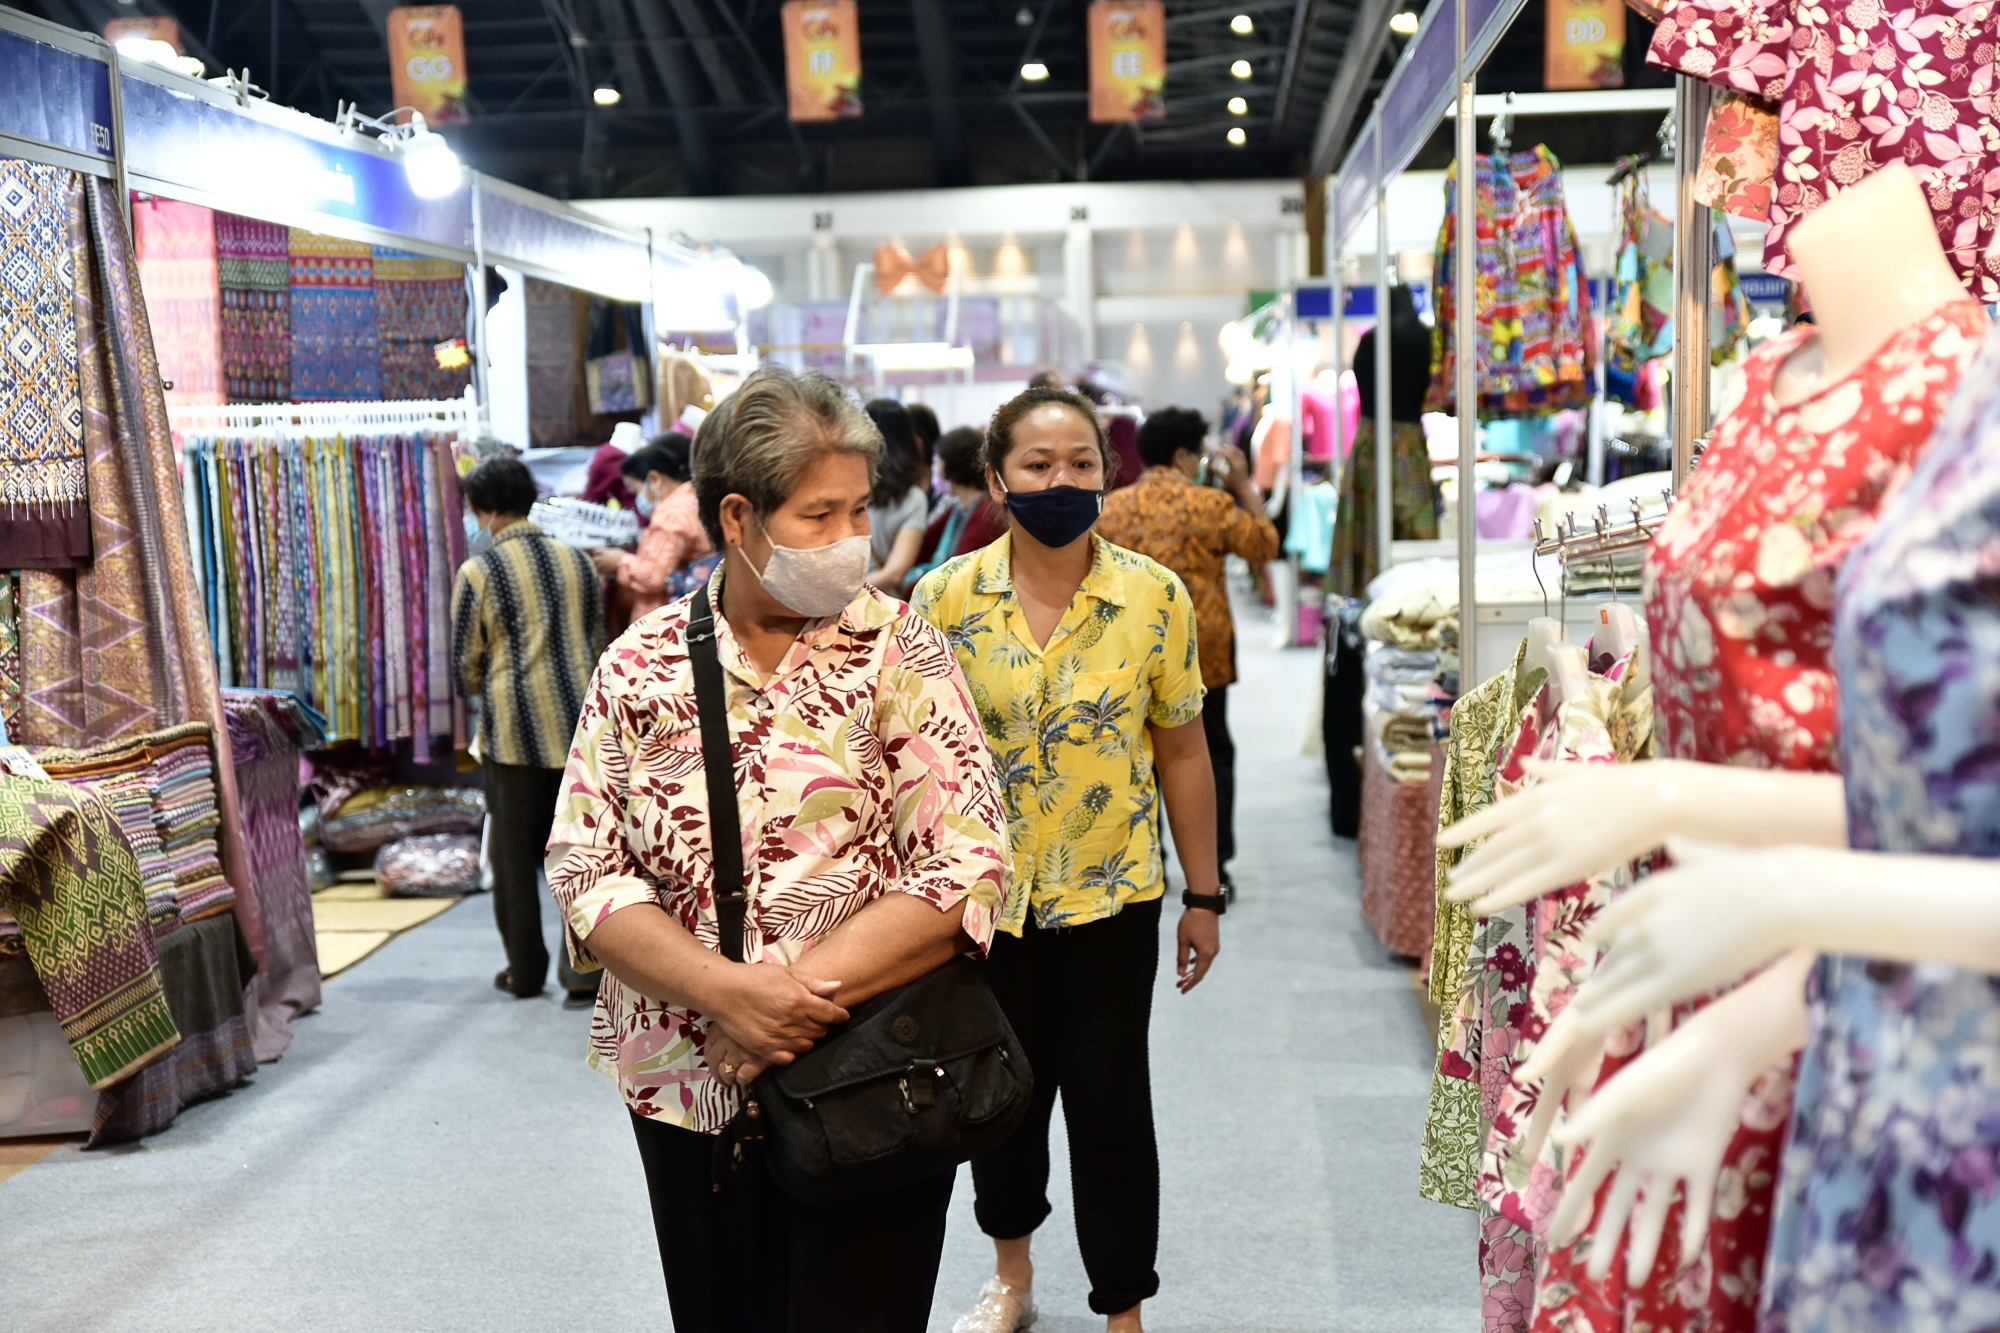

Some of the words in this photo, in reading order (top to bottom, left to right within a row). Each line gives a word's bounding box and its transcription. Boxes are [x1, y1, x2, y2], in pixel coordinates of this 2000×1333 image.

[1565, 18, 1606, 44] DD
[405, 54, 453, 82] GG
[809, 49, 834, 75] FF
[1112, 51, 1142, 77] EE
[90, 121, 110, 151] EE50
